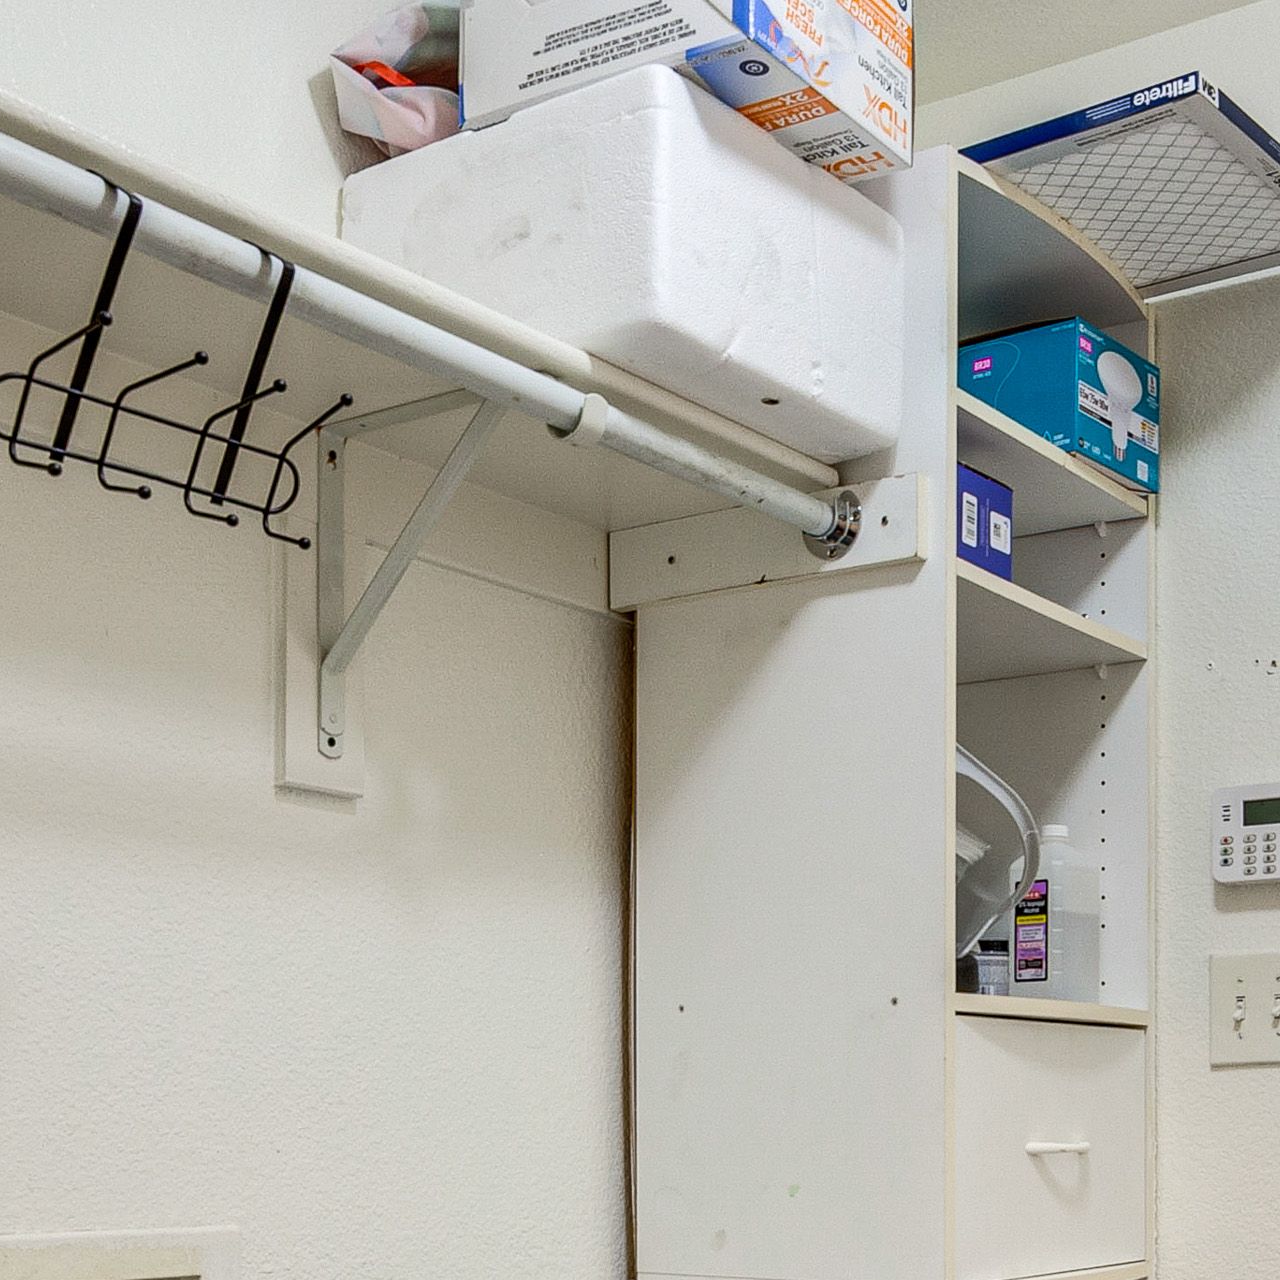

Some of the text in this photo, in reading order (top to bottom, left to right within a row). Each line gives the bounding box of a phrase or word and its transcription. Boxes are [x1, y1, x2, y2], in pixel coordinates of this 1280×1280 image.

[785, 8, 823, 48] FRESH
[881, 25, 907, 64] DURA
[858, 55, 891, 94] Kitchen
[1133, 74, 1196, 106] Filtrete
[774, 106, 826, 127] DURA
[863, 84, 907, 149] HDX
[803, 134, 859, 153] 13 Gallon
[839, 141, 870, 153] Tall
